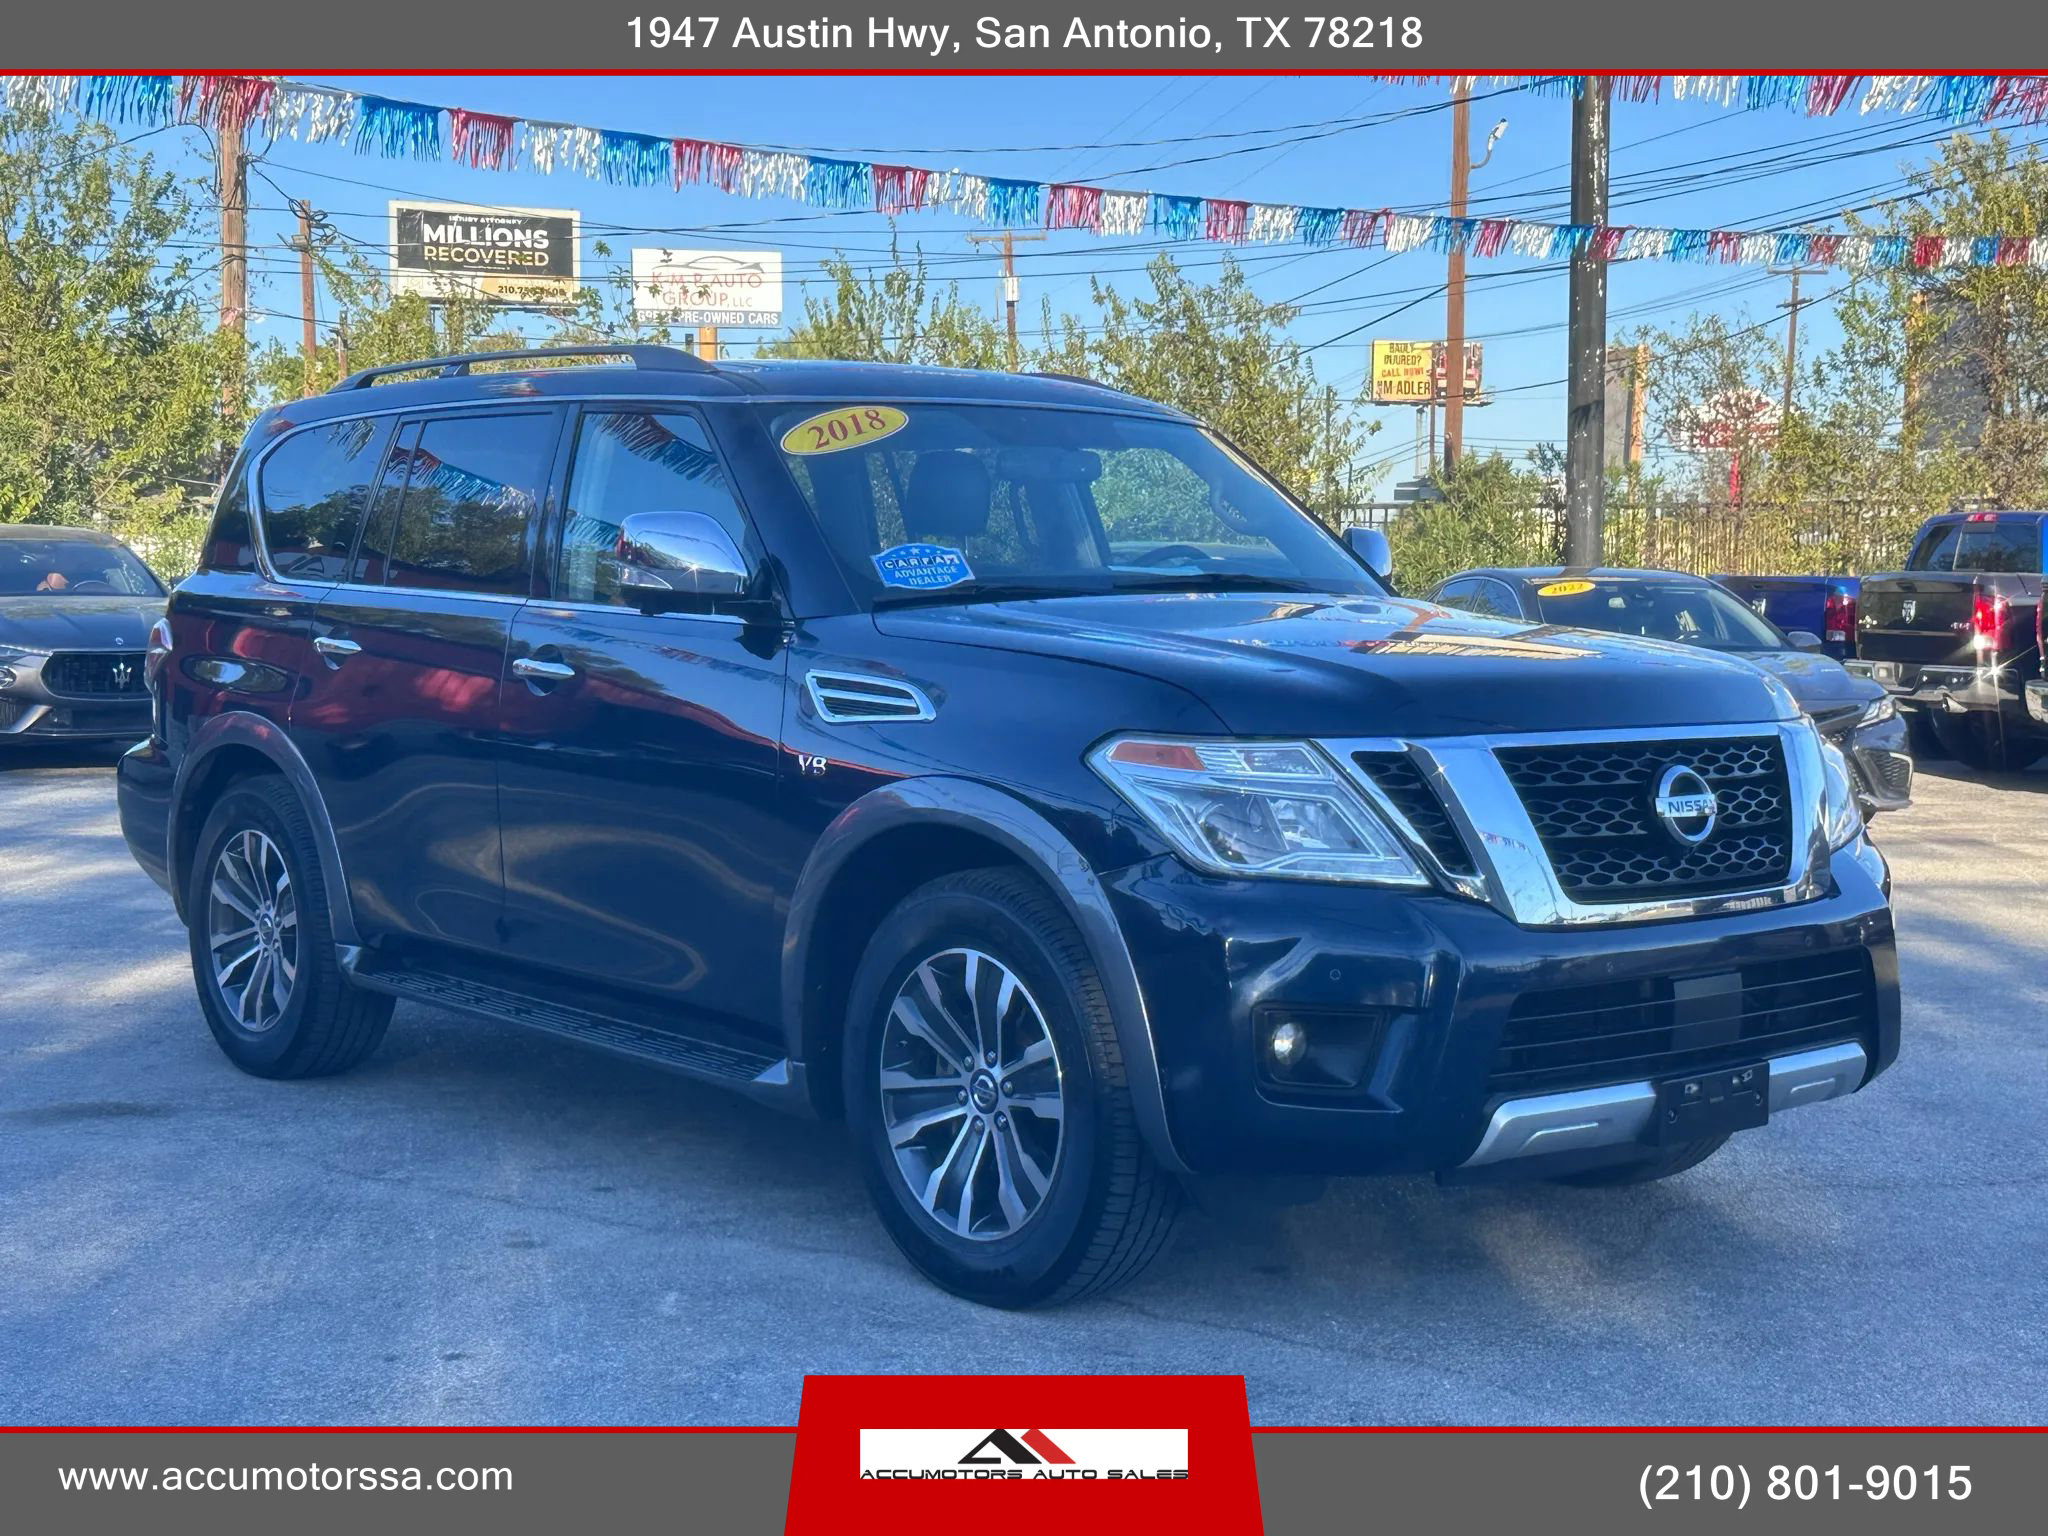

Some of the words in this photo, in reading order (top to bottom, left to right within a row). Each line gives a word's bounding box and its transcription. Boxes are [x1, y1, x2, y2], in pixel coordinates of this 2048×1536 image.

[423, 223, 550, 250] MILLIONS
[424, 244, 550, 268] RECOVERED
[710, 272, 763, 289] AUTO
[748, 312, 779, 325] CARS
[1384, 355, 1422, 365] INJURED?
[1382, 368, 1401, 377] CALL
[1396, 380, 1431, 396] ADLER
[807, 408, 886, 450] 2018
[894, 566, 958, 579] ADVANTAGE
[908, 575, 953, 585] DEALER
[798, 753, 828, 776] V8
